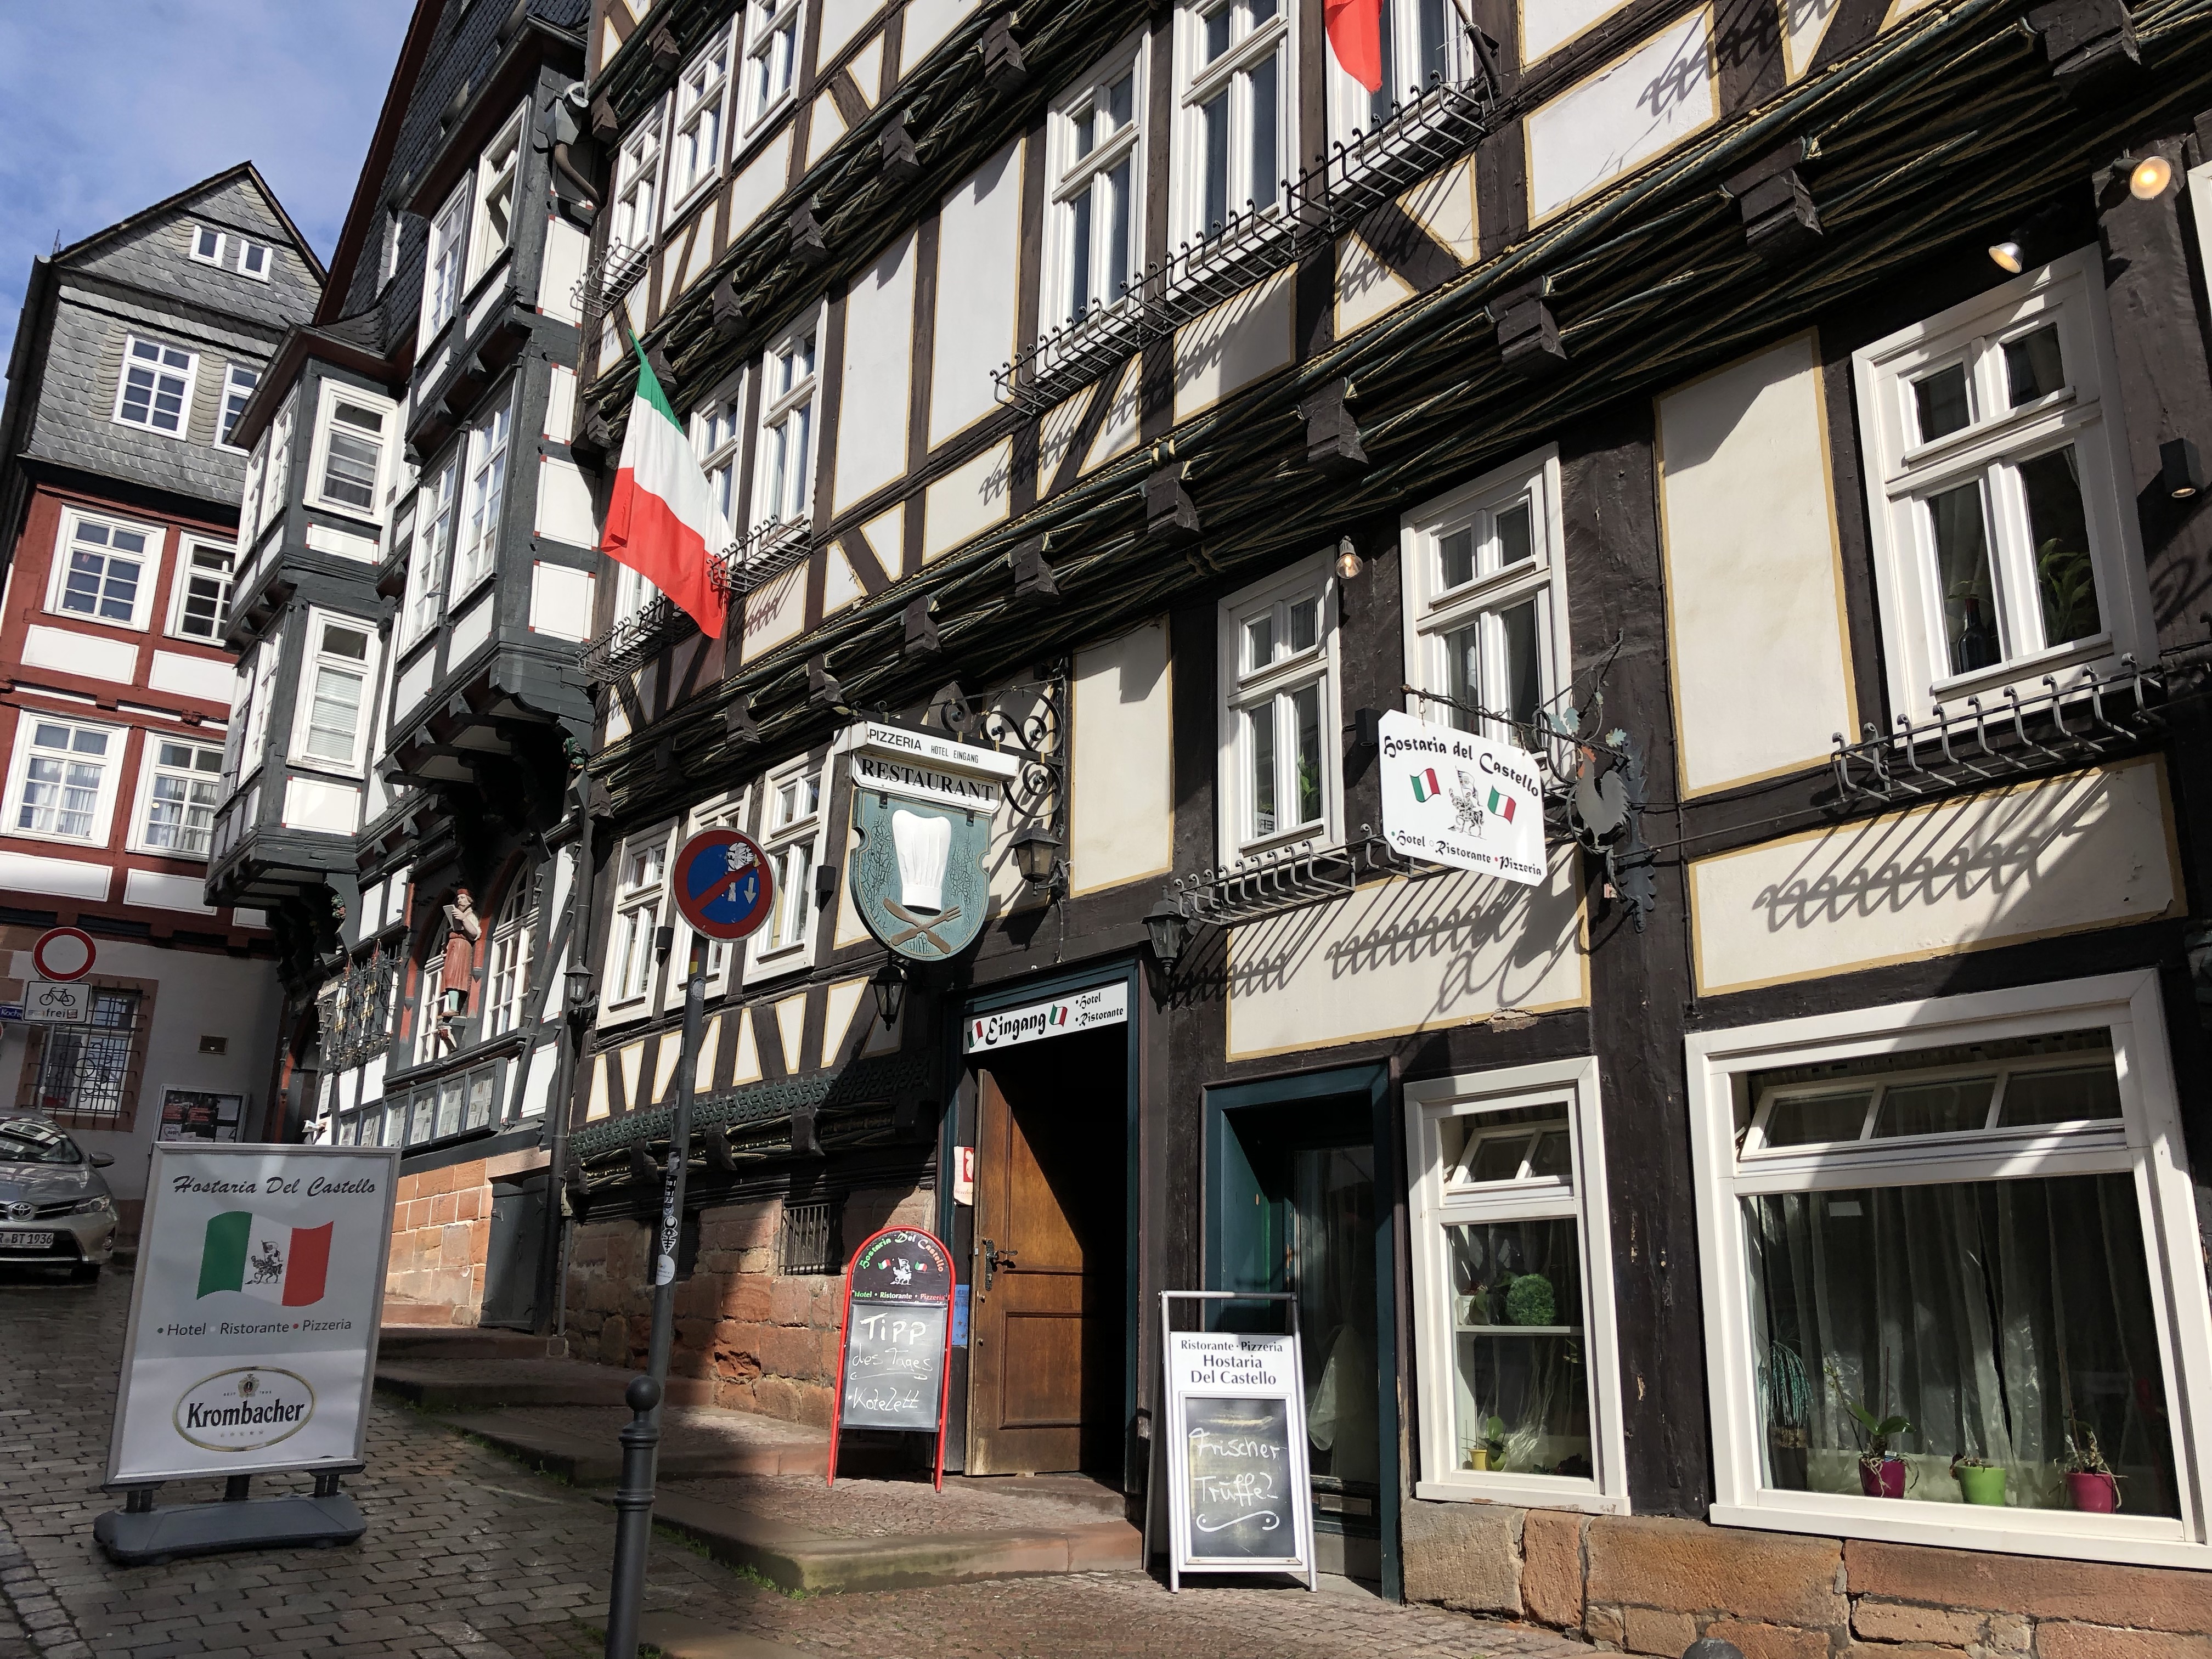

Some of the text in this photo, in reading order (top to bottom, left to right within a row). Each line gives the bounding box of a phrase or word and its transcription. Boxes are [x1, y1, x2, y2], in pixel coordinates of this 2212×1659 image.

[869, 729, 979, 764] PIZZERIA HOTEL EINGANG
[1384, 735, 1539, 797] Hostaria del Castello
[861, 758, 994, 802] RESTAURANT
[1396, 830, 1542, 876] Hotel Ristorante Pizzeria
[1079, 992, 1101, 1009] Hotel
[46, 1008, 66, 1018] frei
[1079, 1007, 1124, 1026] Ristorante
[985, 1013, 1046, 1045] Eingang
[173, 1175, 376, 1197] Hostaria Del Castello
[12, 1233, 25, 1244] BT
[27, 1234, 53, 1244] 1936
[859, 1232, 945, 1272] Hostaria Del Castello
[879, 1291, 912, 1300] Ristorante
[167, 1318, 352, 1336] Hotel Ristorante Pizzeria
[1181, 1339, 1283, 1352] Ristorante Pizzeria
[852, 1343, 933, 1372] des Tages
[1203, 1354, 1262, 1368] Hostaria
[1191, 1370, 1276, 1385] Del Castello
[187, 1398, 305, 1429] Krombacher
[1188, 1427, 1283, 1460] Frischer
